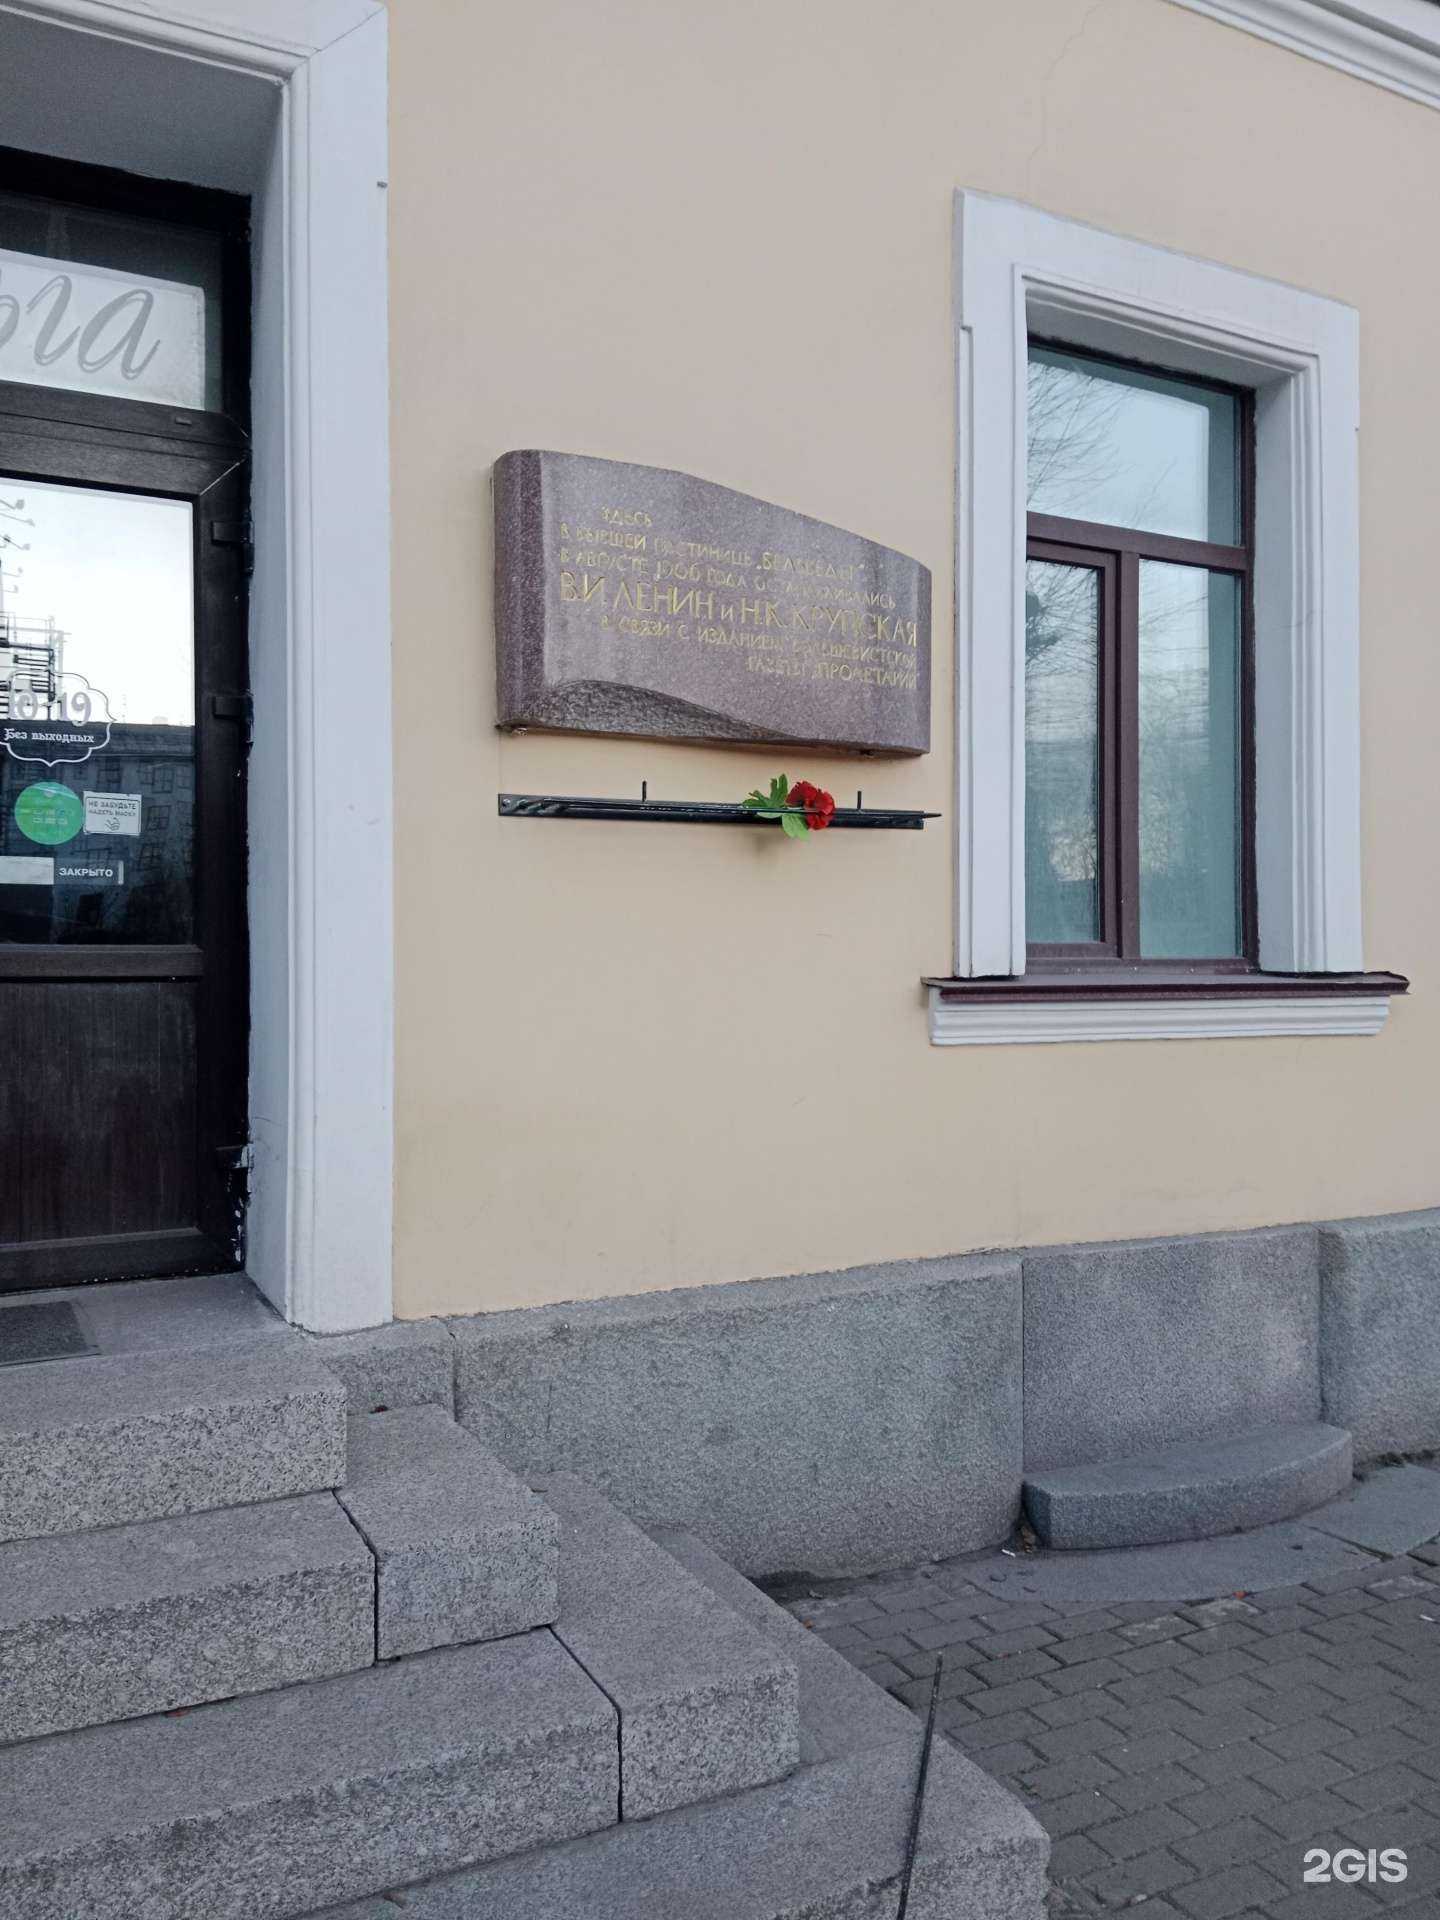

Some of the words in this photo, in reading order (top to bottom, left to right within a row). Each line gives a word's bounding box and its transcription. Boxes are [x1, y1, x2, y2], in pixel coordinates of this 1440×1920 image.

[611, 577, 714, 620] ЛЕНИН
[792, 603, 917, 648] КРУПСКАЯ
[3, 728, 28, 741] Без
[31, 732, 95, 744] выходных
[59, 867, 114, 877] ЗАКРЫТО
